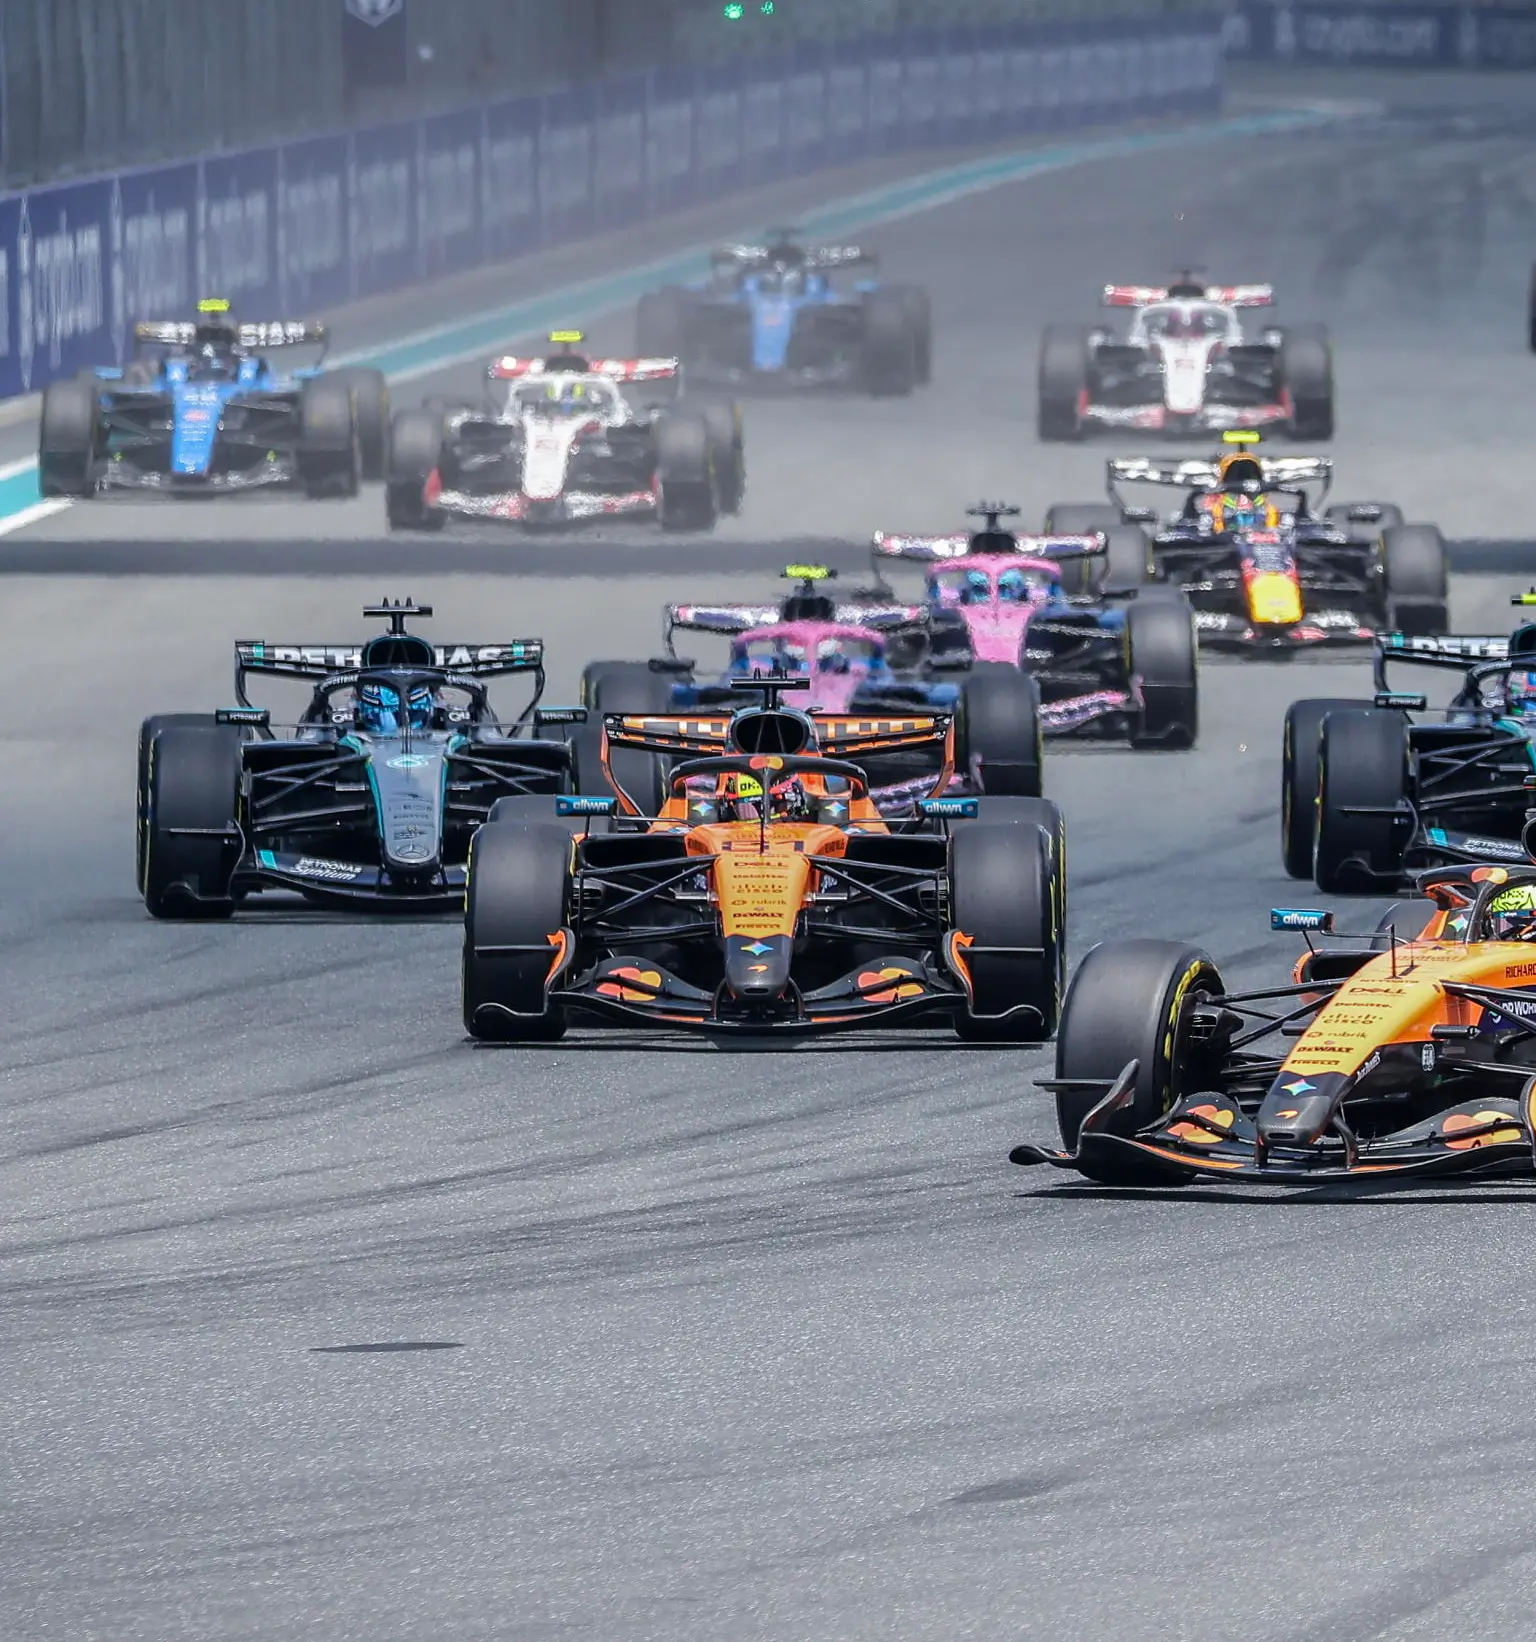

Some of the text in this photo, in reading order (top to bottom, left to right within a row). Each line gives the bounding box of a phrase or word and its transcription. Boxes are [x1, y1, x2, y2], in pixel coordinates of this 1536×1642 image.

[572, 799, 609, 812] allwyn
[925, 802, 963, 815] allwyn
[291, 862, 357, 881] Syntium
[300, 857, 363, 873] PETRONAS
[1283, 913, 1318, 928] allwyn
[1328, 1031, 1367, 1039] rubrik
